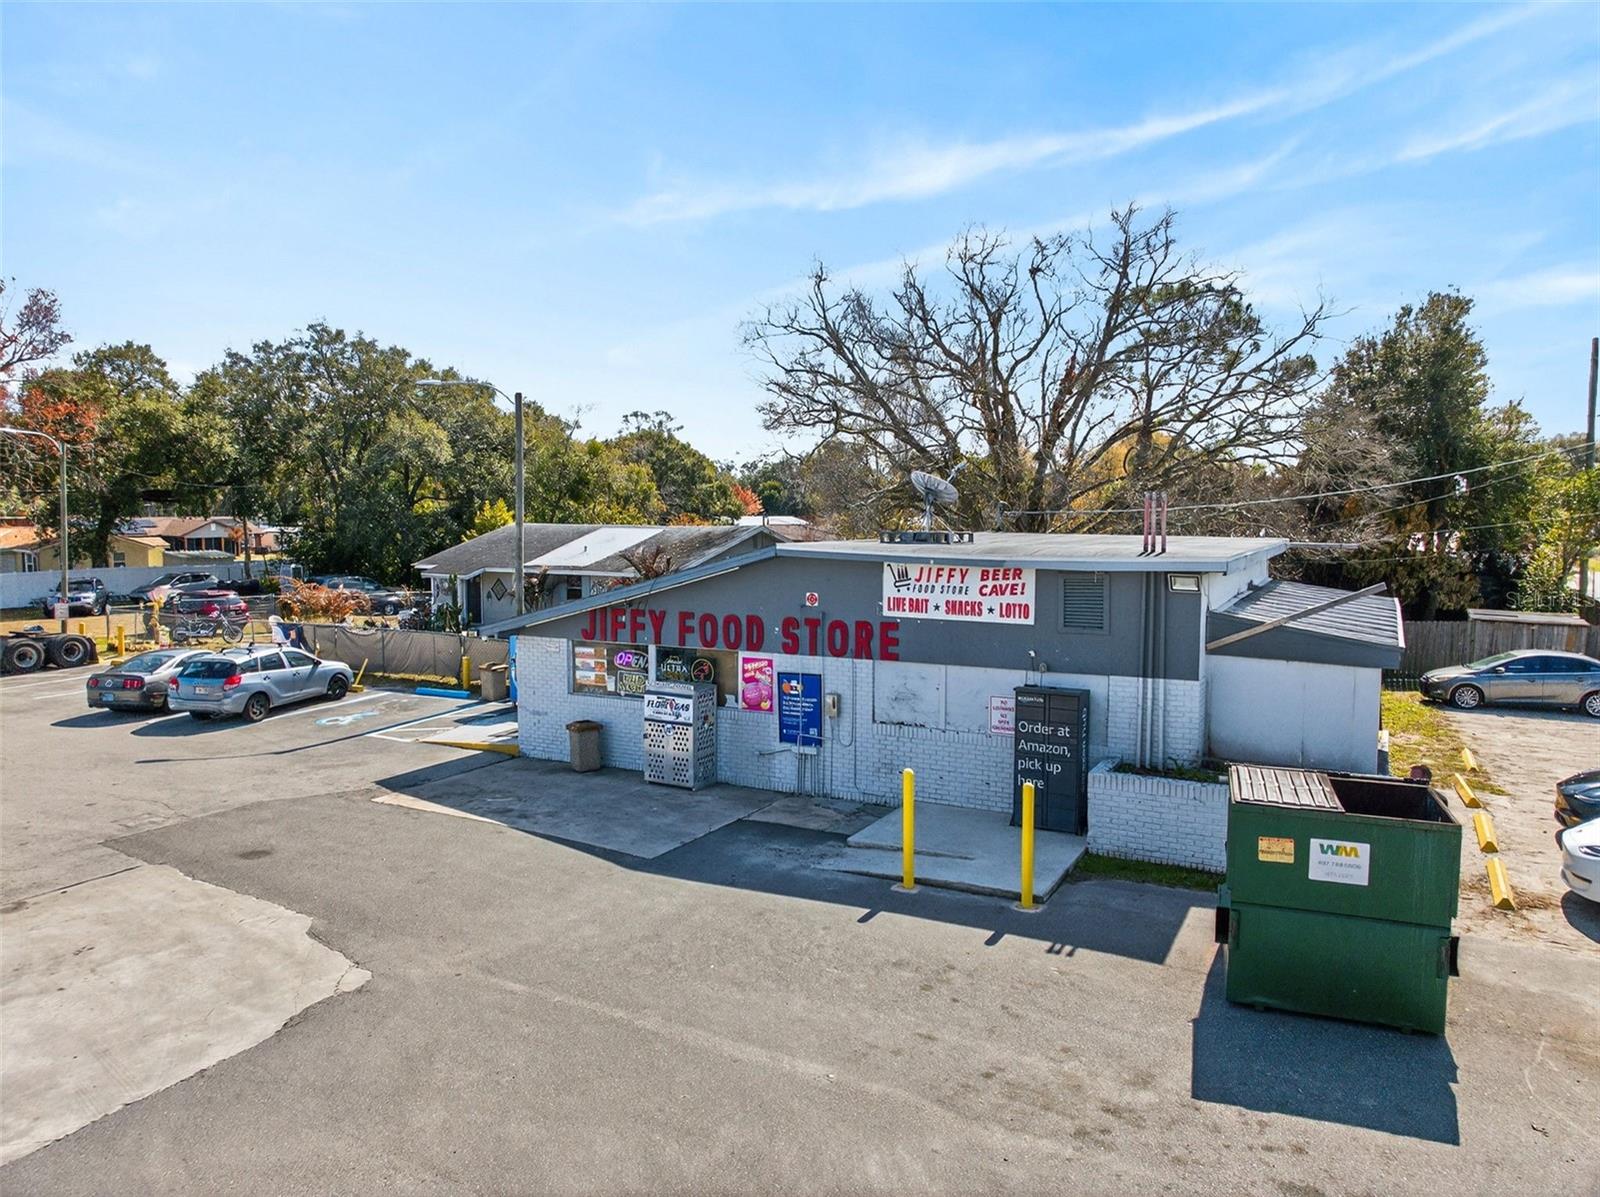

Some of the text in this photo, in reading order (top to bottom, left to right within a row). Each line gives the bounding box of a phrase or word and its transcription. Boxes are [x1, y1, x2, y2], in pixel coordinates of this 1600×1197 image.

[914, 566, 970, 584] JIFFY
[980, 567, 1024, 582] BEER
[912, 584, 969, 596] FOOD STORE
[978, 583, 1026, 597] CAVE!
[887, 596, 1030, 620] LIVE BAIT SNACKS LOTTO
[580, 606, 900, 661] JIFFY FOOD STORE
[616, 651, 648, 668] OPEN
[660, 663, 688, 673] ULTRA
[1018, 720, 1054, 735] Order
[1057, 726, 1070, 737] at
[1018, 739, 1071, 758] Amazon,
[1018, 757, 1062, 775] pick up
[1319, 843, 1360, 858] WM
